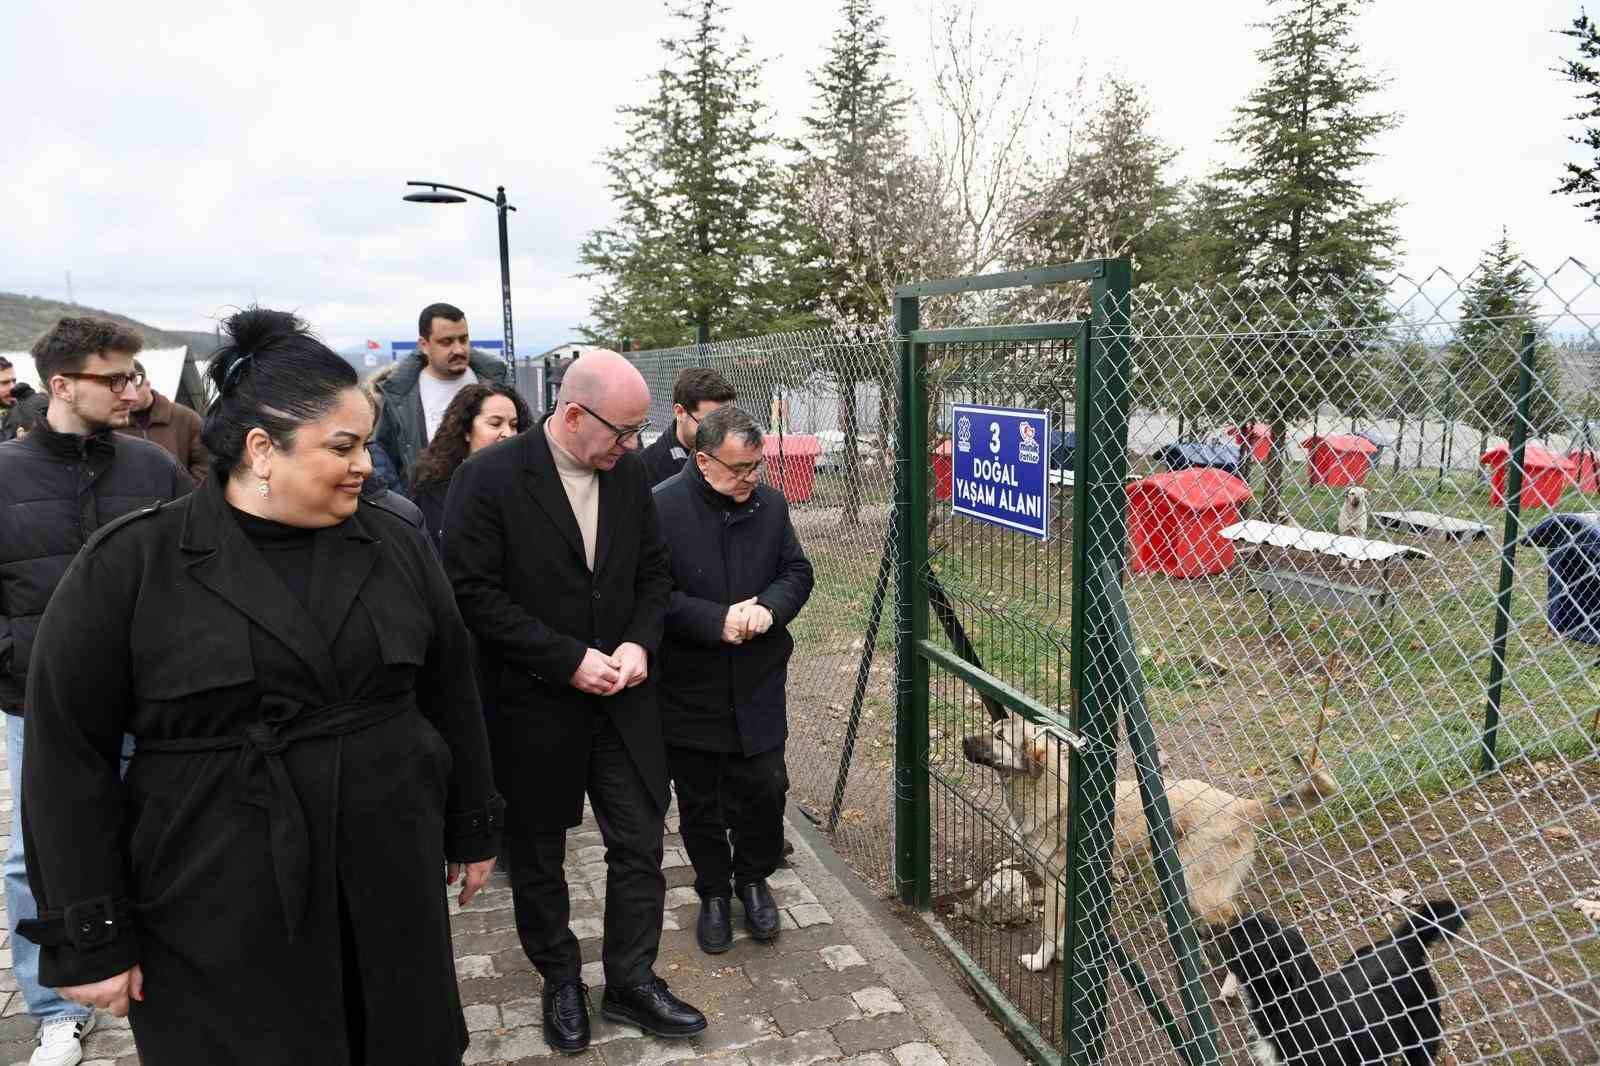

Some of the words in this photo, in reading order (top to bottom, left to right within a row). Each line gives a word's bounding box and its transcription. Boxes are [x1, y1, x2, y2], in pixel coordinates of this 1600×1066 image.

[989, 422, 1000, 453] 3
[973, 456, 1018, 487] DOĞAL
[956, 478, 995, 507] YAŞAM
[999, 489, 1041, 518] ALANI
